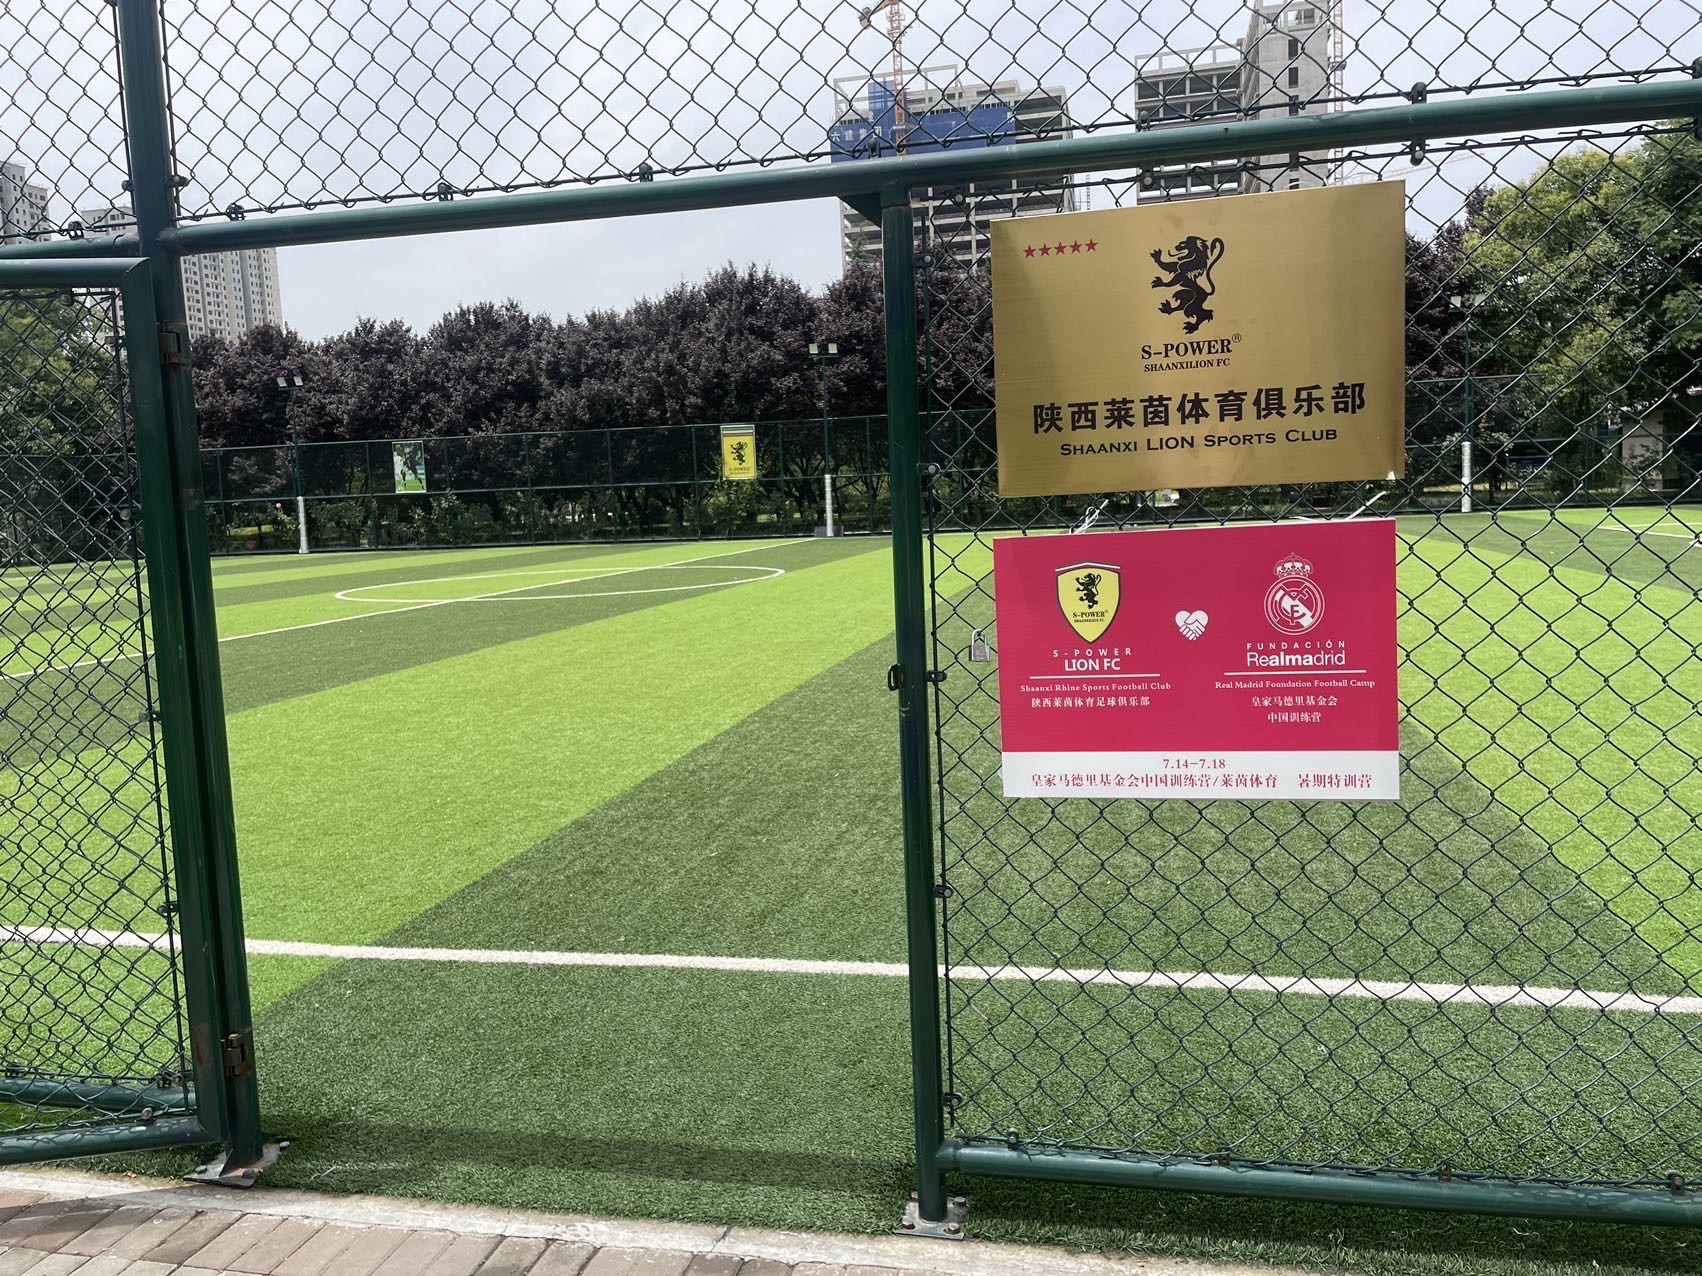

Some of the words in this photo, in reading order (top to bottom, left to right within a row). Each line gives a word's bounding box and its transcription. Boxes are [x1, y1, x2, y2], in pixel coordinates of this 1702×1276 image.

[1144, 359, 1214, 373] SHAANXILION
[1216, 358, 1231, 368] FC
[1033, 382, 1366, 434] 陕西莱茵体育俱乐部
[1146, 435, 1195, 451] LION
[1246, 640, 1345, 651] FUNDACIÓN
[1064, 659, 1100, 671] LION
[1103, 658, 1121, 671] FC
[1247, 650, 1346, 667] Realmadrid
[1020, 684, 1053, 693] Shaanxi
[1055, 684, 1080, 692] Rhine
[1082, 683, 1110, 693] Sports
[1112, 682, 1148, 691] Football
[1150, 682, 1172, 690] Club
[1215, 681, 1233, 689] Real
[1235, 681, 1264, 689] Madrid
[1265, 680, 1312, 689] Foundation
[1314, 679, 1348, 687] Football
[1350, 679, 1376, 689] Camp
[1031, 696, 1150, 709] 陕西莱茵体育足球俱乐部
[1252, 695, 1338, 708] 皇家马德里基金会
[1267, 712, 1322, 723] 中国训练营
[1031, 773, 1278, 788] 皇家马德里基金会中国训练营/莱茵体育
[1298, 773, 1372, 788] 暑期特训营
